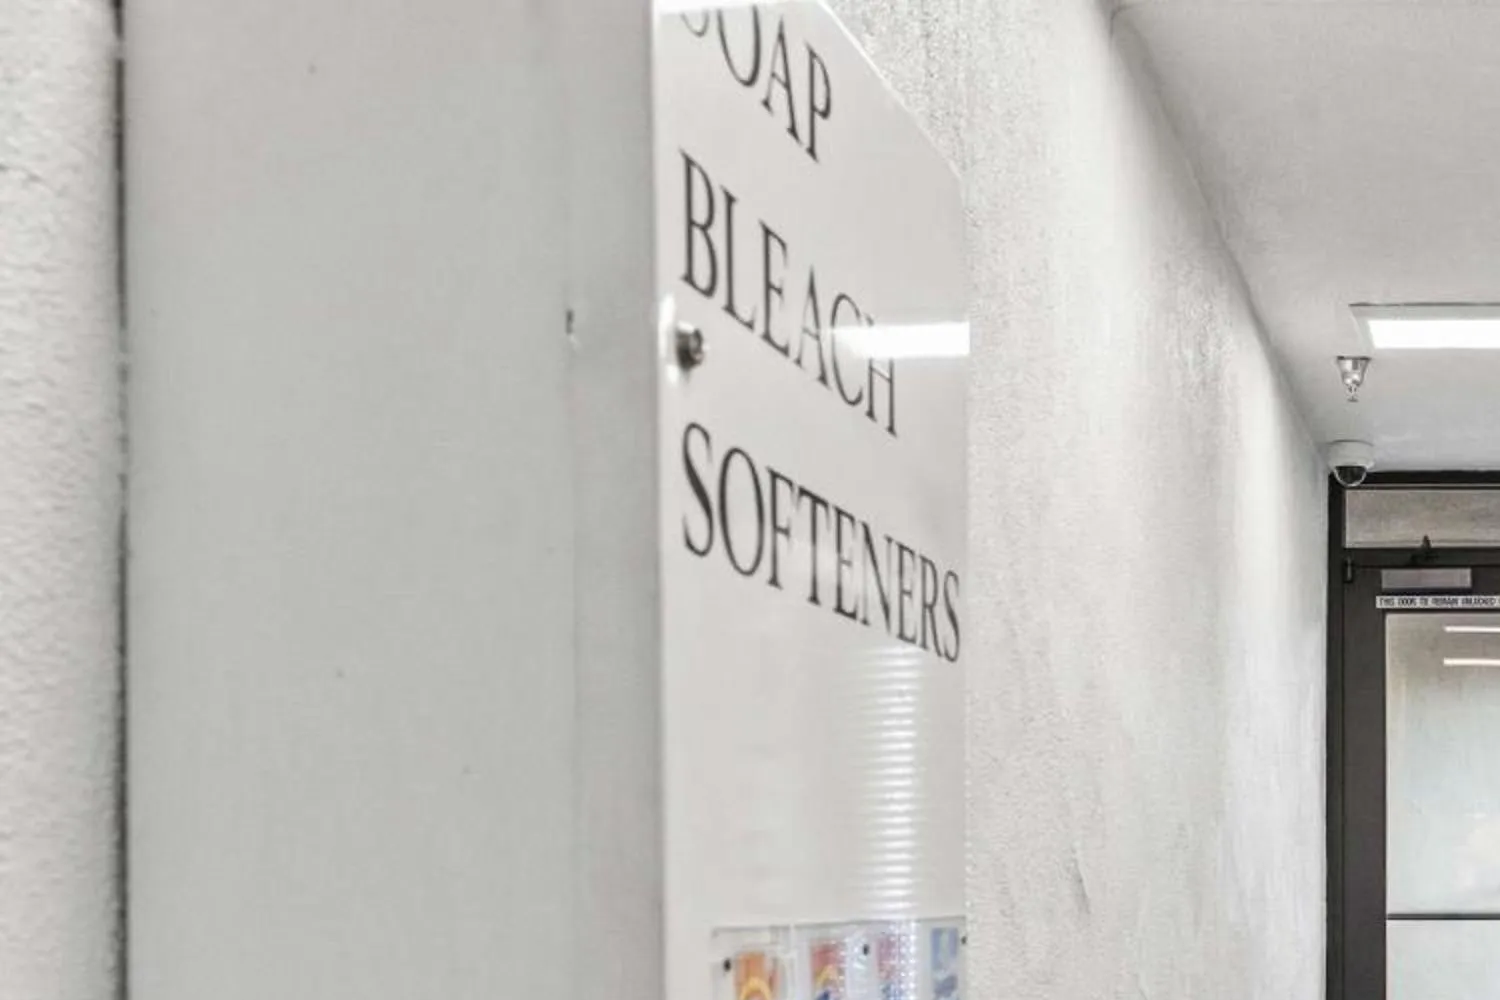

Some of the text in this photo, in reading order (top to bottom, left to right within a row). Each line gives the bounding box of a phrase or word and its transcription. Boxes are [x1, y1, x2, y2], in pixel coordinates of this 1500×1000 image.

[681, 3, 832, 162] OAP
[680, 147, 898, 437] BLEACH
[682, 421, 961, 664] SOFTENERS
